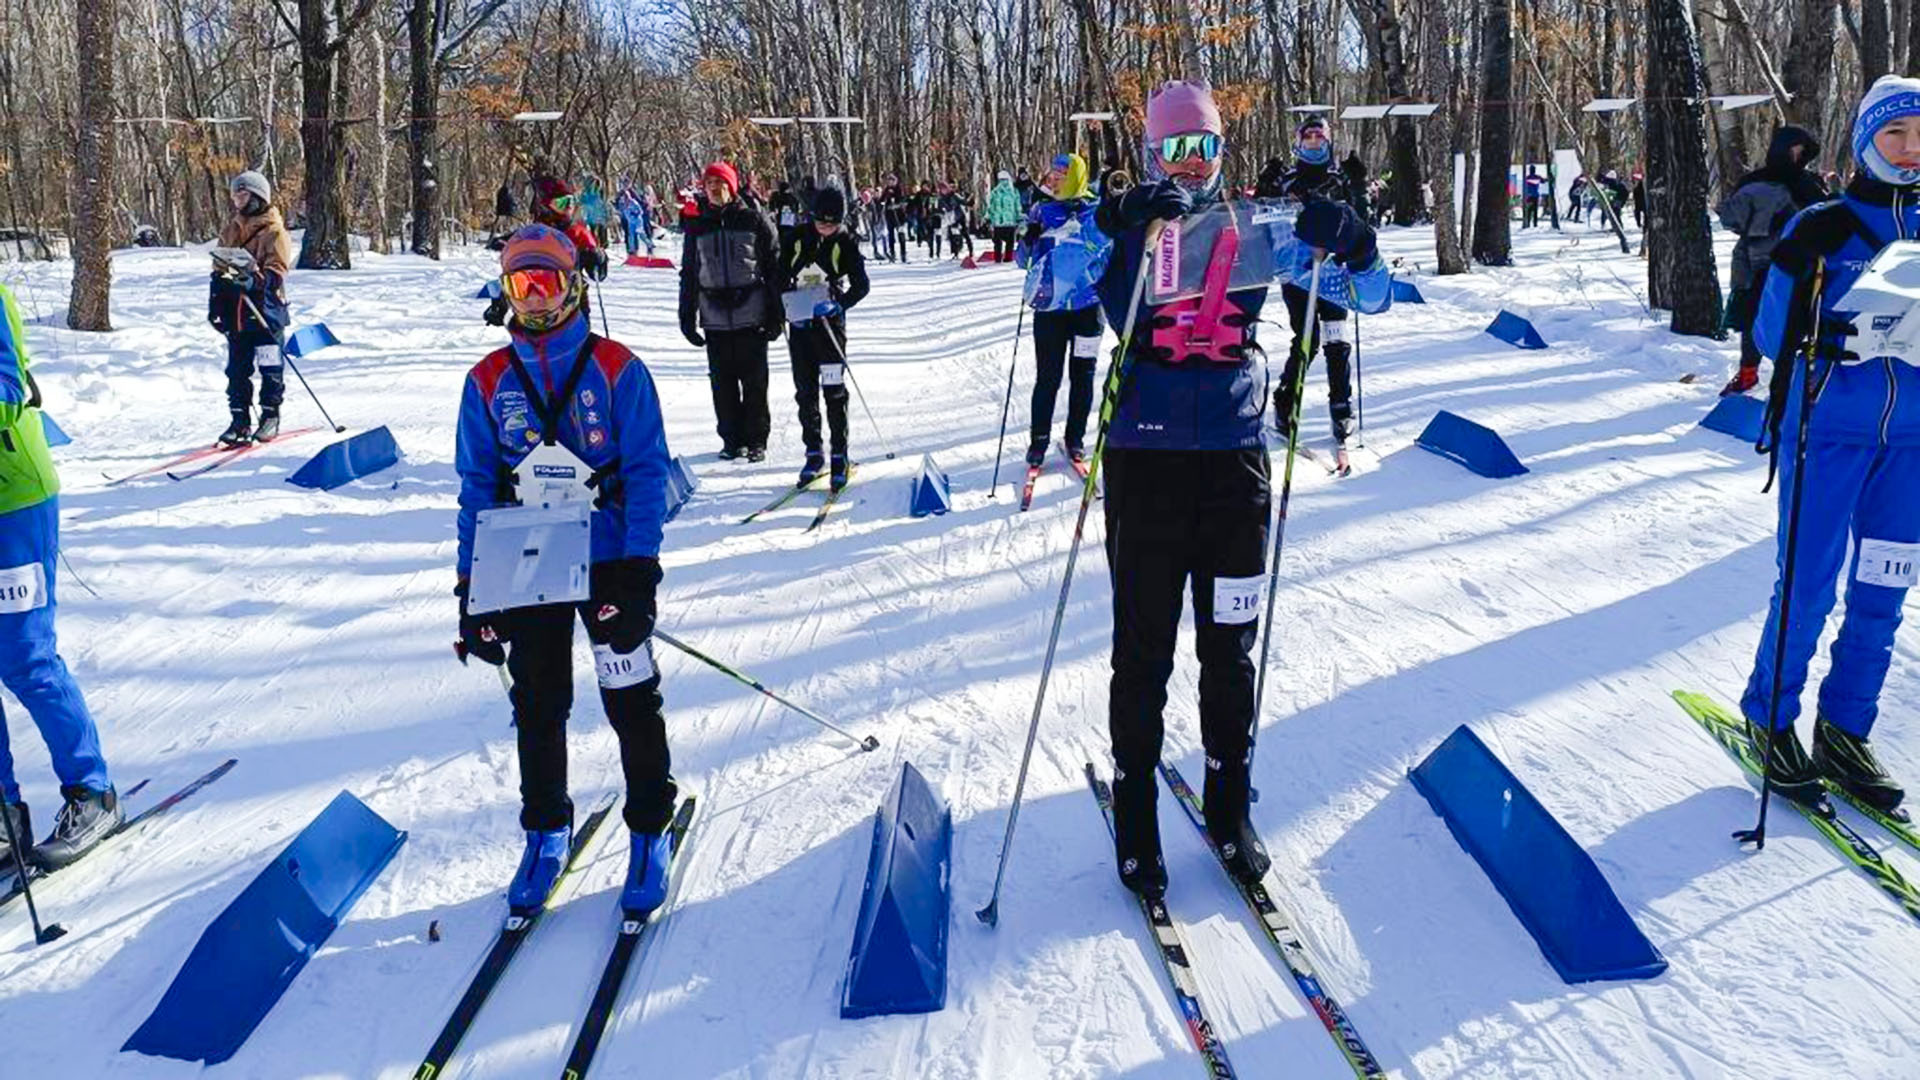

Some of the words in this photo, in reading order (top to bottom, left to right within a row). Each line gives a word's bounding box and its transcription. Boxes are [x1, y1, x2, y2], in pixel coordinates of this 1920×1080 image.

[1162, 228, 1174, 287] MAGNETO
[1883, 560, 1912, 575] 110
[1232, 593, 1259, 611] 210
[604, 658, 632, 676] 310
